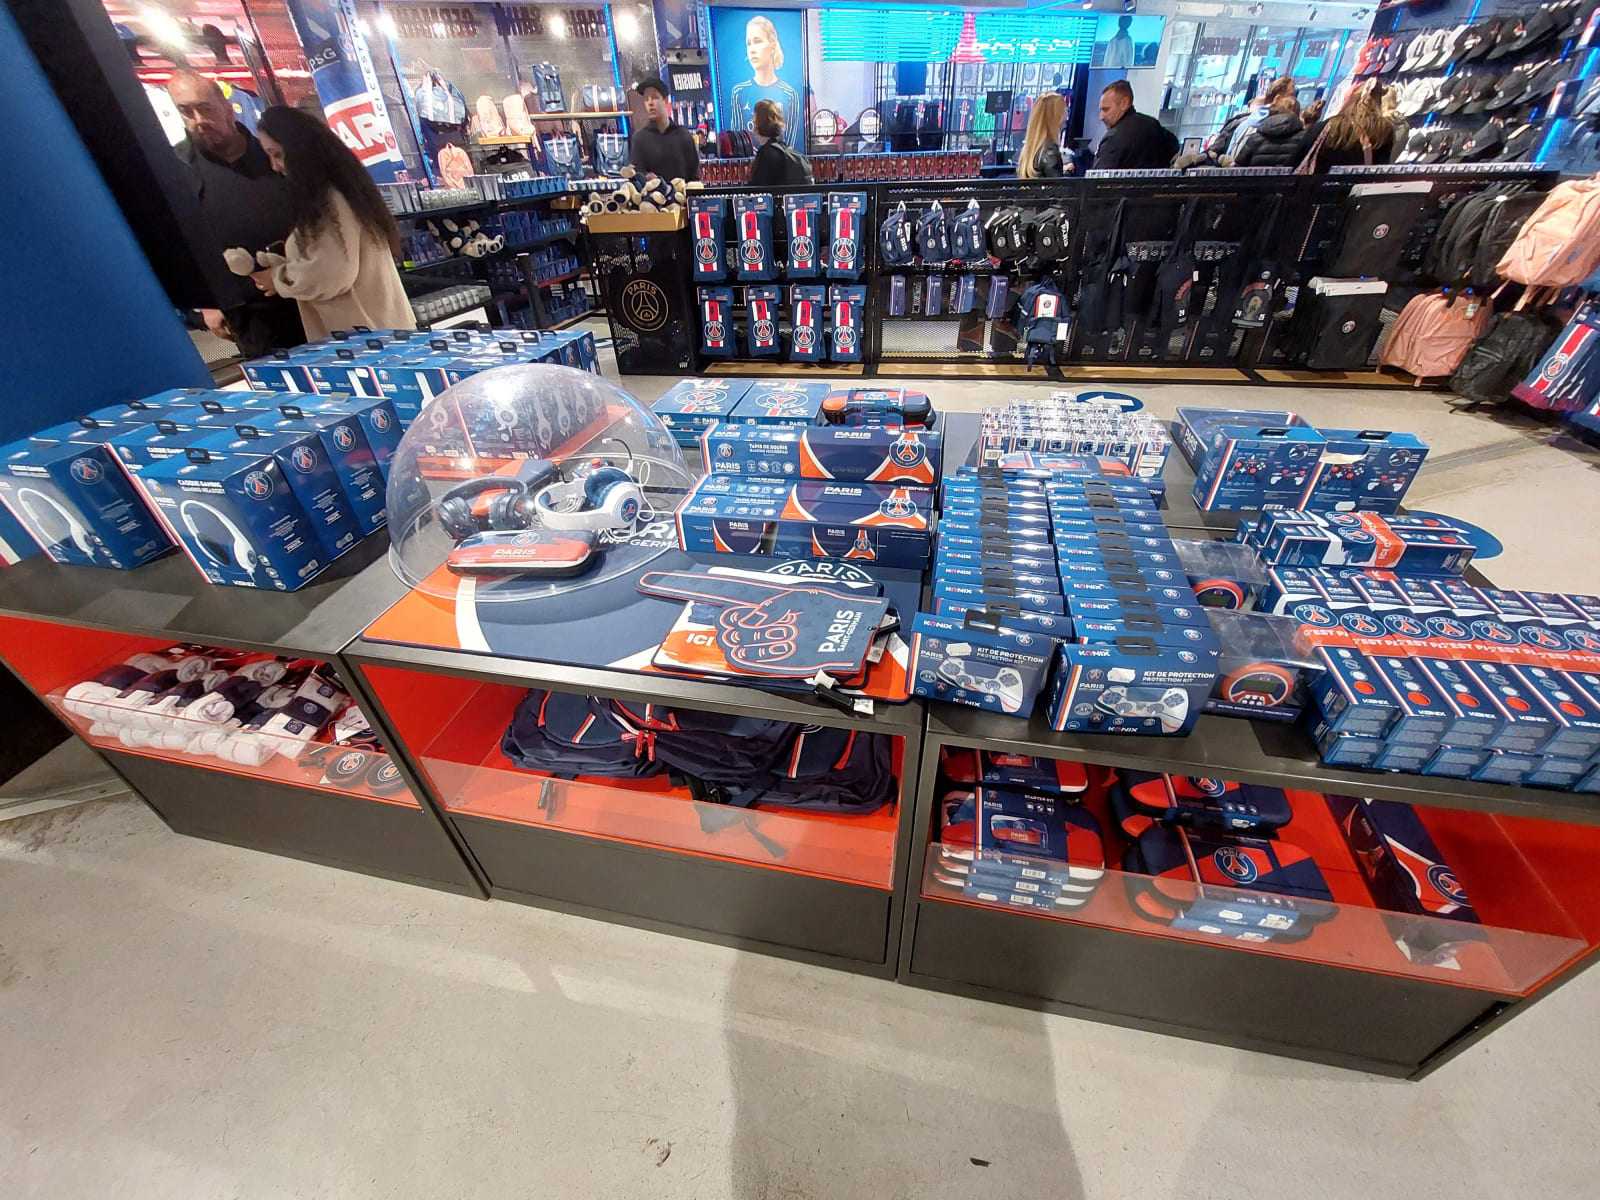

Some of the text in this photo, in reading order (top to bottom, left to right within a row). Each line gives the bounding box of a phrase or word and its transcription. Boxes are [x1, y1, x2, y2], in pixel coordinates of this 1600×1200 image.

[308, 47, 337, 69] PSG
[332, 113, 384, 151] AR
[627, 281, 658, 296] PARIS
[778, 562, 860, 581] PARIS
[946, 568, 972, 576] KONIX
[946, 586, 972, 594] KONIX
[1074, 583, 1102, 591] KONIX
[1080, 602, 1110, 610] KONIX
[924, 620, 952, 630] KONIX
[1086, 624, 1117, 632] KONIX
[818, 610, 854, 653] PARIS
[837, 612, 864, 653] SAINT-GERMAIN
[686, 632, 715, 647] ICI
[920, 650, 944, 659] PARIS
[976, 652, 1013, 663] PROTECTION
[1000, 650, 1044, 664] PROTECTION
[952, 698, 981, 708] KONIX
[1218, 848, 1245, 860] PARIS
